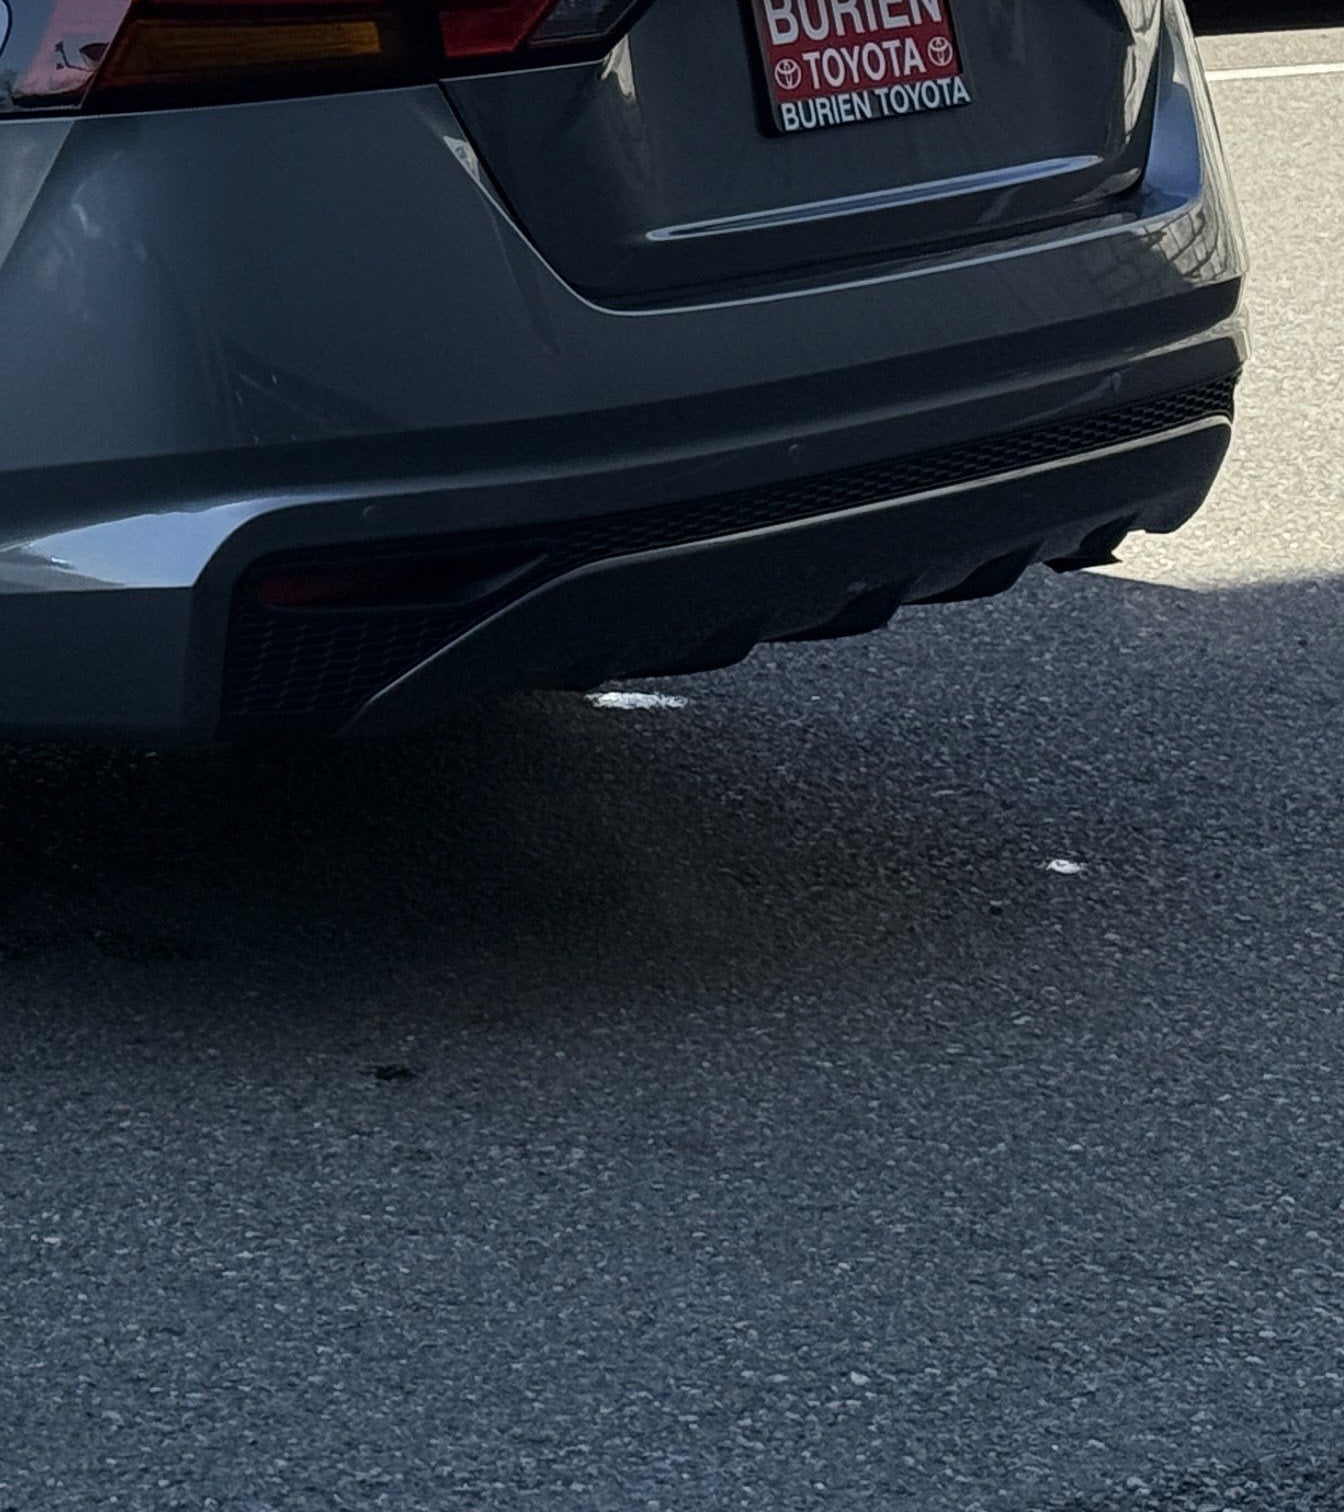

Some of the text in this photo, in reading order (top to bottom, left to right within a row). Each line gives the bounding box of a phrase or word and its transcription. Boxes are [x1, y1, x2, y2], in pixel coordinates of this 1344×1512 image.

[803, 38, 927, 89] TOYOTA
[781, 77, 971, 131] BURIEN TOYOTA
